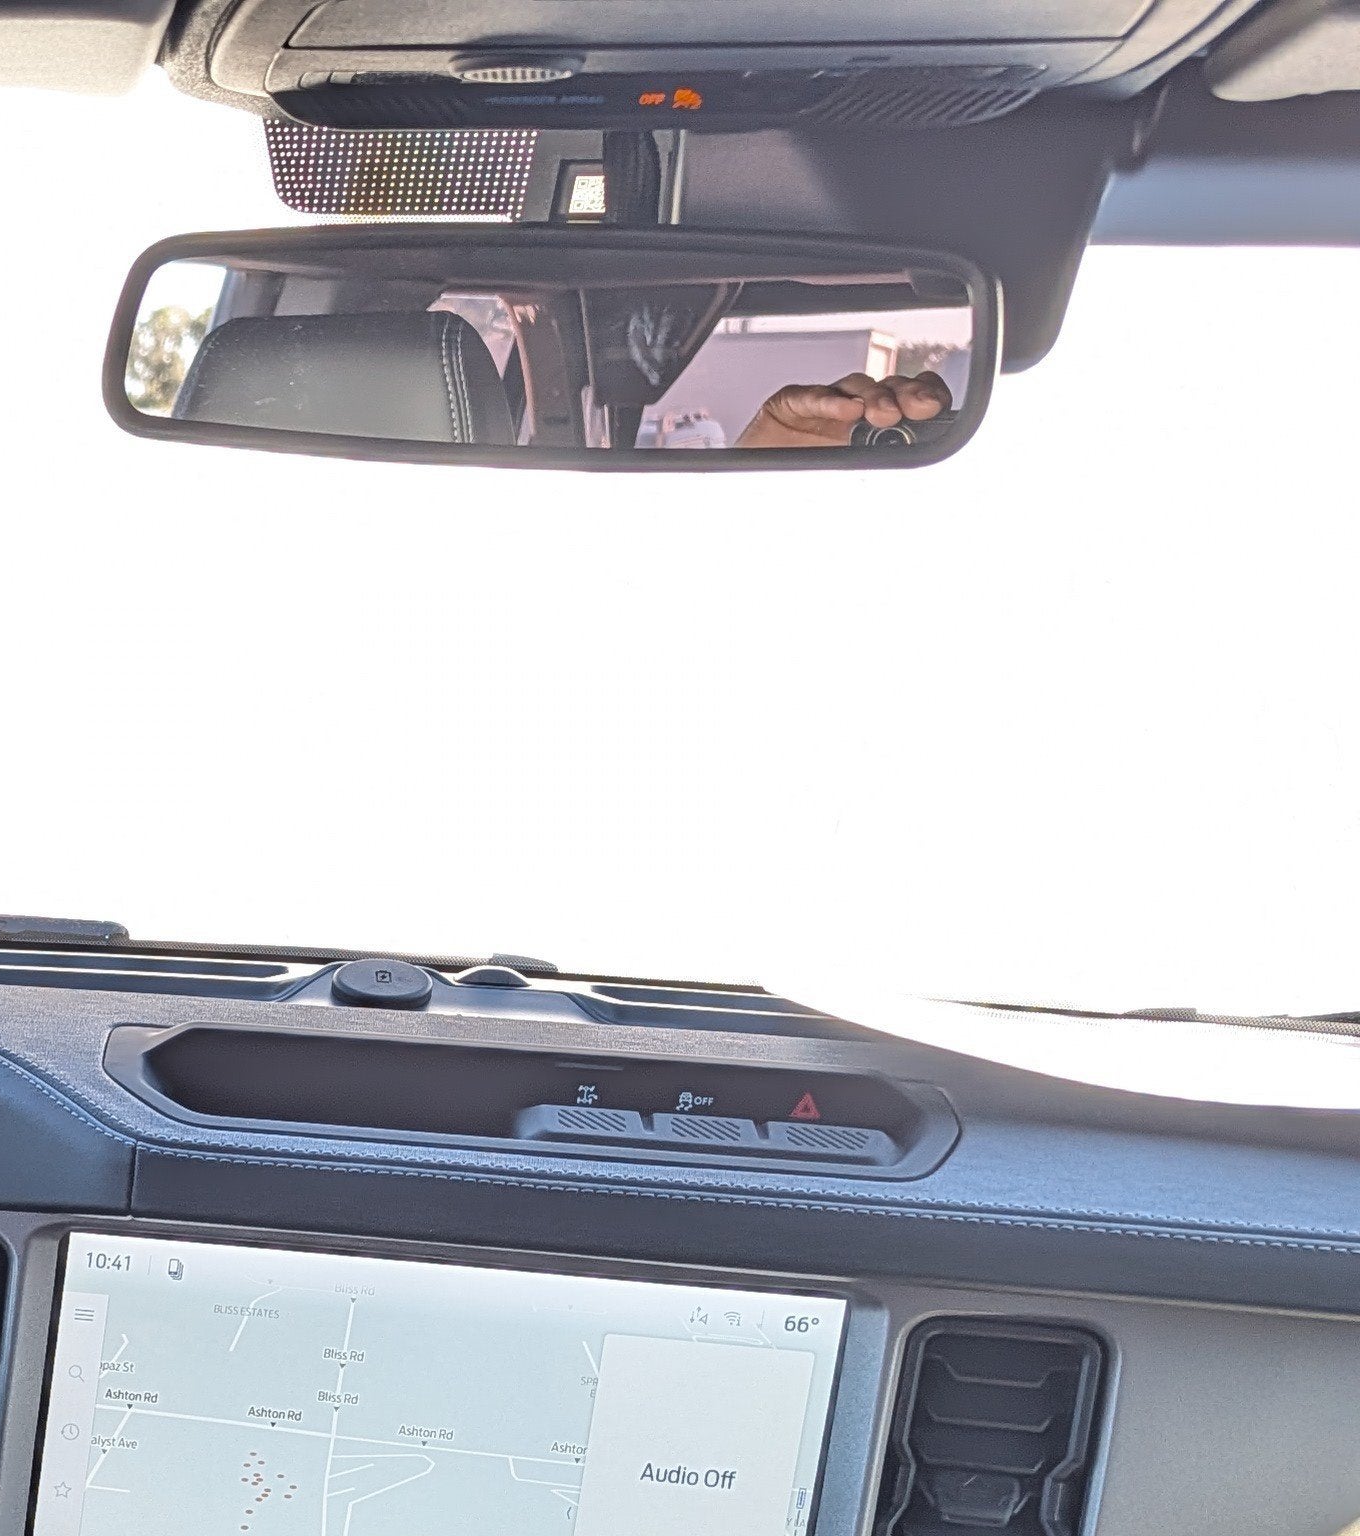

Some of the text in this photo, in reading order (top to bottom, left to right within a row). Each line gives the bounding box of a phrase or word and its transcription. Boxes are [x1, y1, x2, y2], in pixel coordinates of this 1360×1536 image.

[694, 1096, 714, 1107] OFF
[85, 1252, 131, 1272] 10:41
[334, 1283, 375, 1296] Bliss Rd
[214, 1304, 280, 1319] BLISS ESTATES
[783, 1315, 820, 1334] 66°
[323, 1348, 365, 1362] Bliss Rd
[123, 1361, 134, 1373] St
[105, 1388, 158, 1404] Ashton Rd
[317, 1391, 359, 1405] Bliss Rd
[248, 1406, 302, 1421] Ashton Rd
[399, 1425, 454, 1441] Ashton Rd
[118, 1436, 138, 1449] Ave
[640, 1462, 737, 1490] Audio Off
